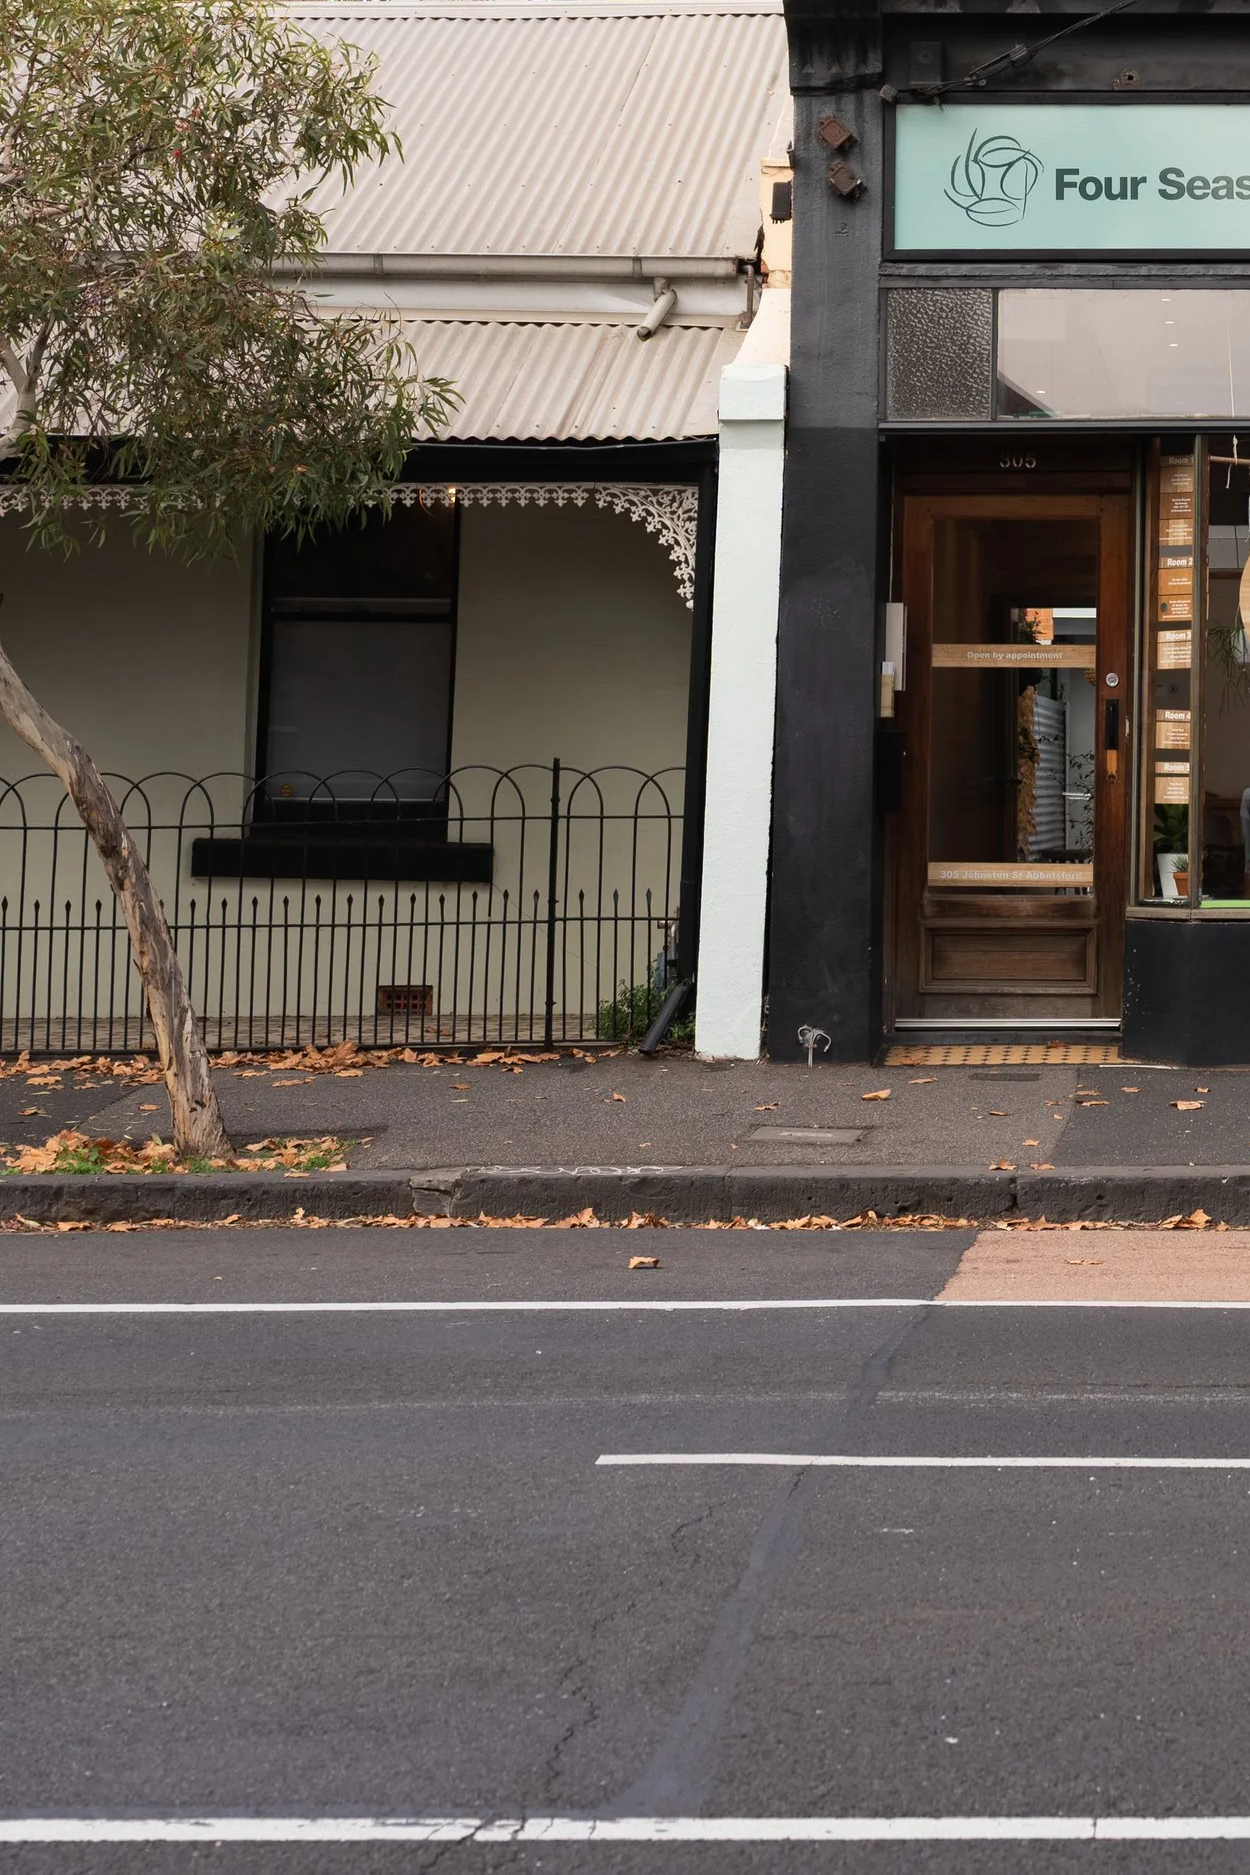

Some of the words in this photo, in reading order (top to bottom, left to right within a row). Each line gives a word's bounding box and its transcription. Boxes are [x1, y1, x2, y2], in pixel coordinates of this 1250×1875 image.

[1055, 168, 1147, 201] Four
[999, 451, 1037, 469] 305
[1168, 456, 1189, 465] Room
[1167, 557, 1187, 566] Room
[1188, 557, 1194, 566] 2
[1165, 631, 1186, 640] Room
[1186, 631, 1192, 640] 3
[967, 651, 990, 660] Open
[992, 651, 1004, 660] by
[1005, 651, 1063, 661] appointment
[1164, 711, 1185, 720] Room
[1185, 711, 1192, 720] 4
[1163, 763, 1185, 772] Room
[940, 870, 959, 879] 305
[962, 870, 1009, 880] Johnston
[1011, 870, 1022, 880] St
[1026, 871, 1082, 881] Abbotsford
